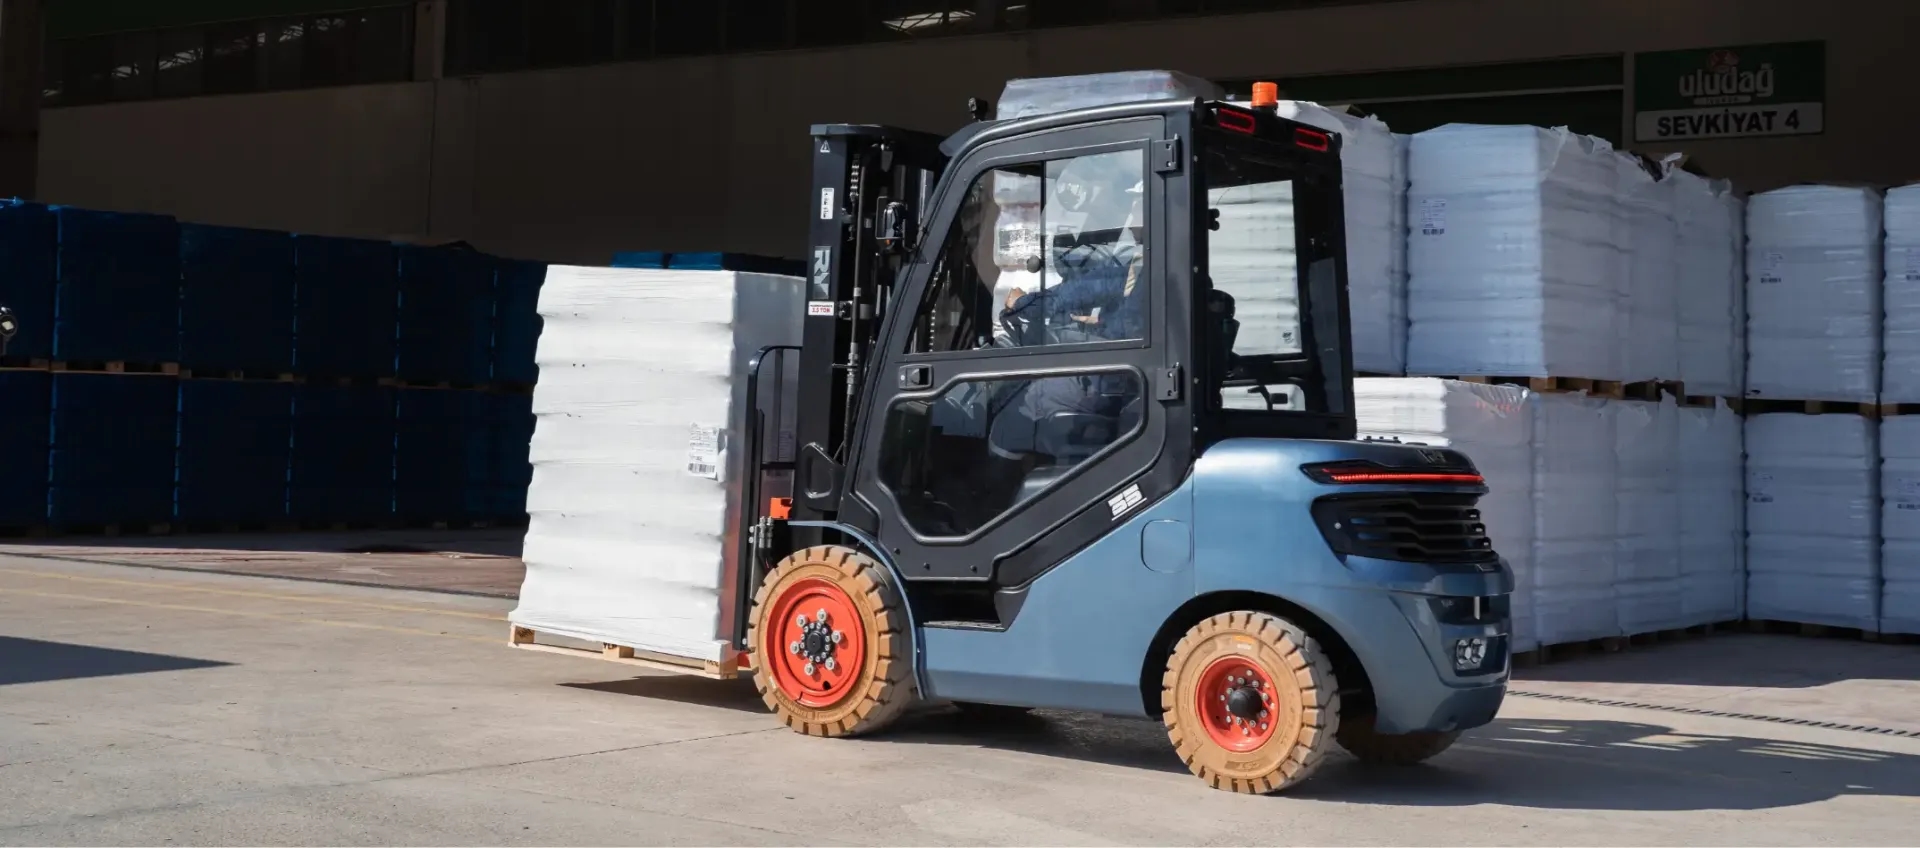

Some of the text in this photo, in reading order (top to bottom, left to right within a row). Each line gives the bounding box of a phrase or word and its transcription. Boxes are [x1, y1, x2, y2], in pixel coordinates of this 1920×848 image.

[1678, 63, 1775, 97] uludağ
[1657, 109, 1800, 136] SEVKİYAT 4
